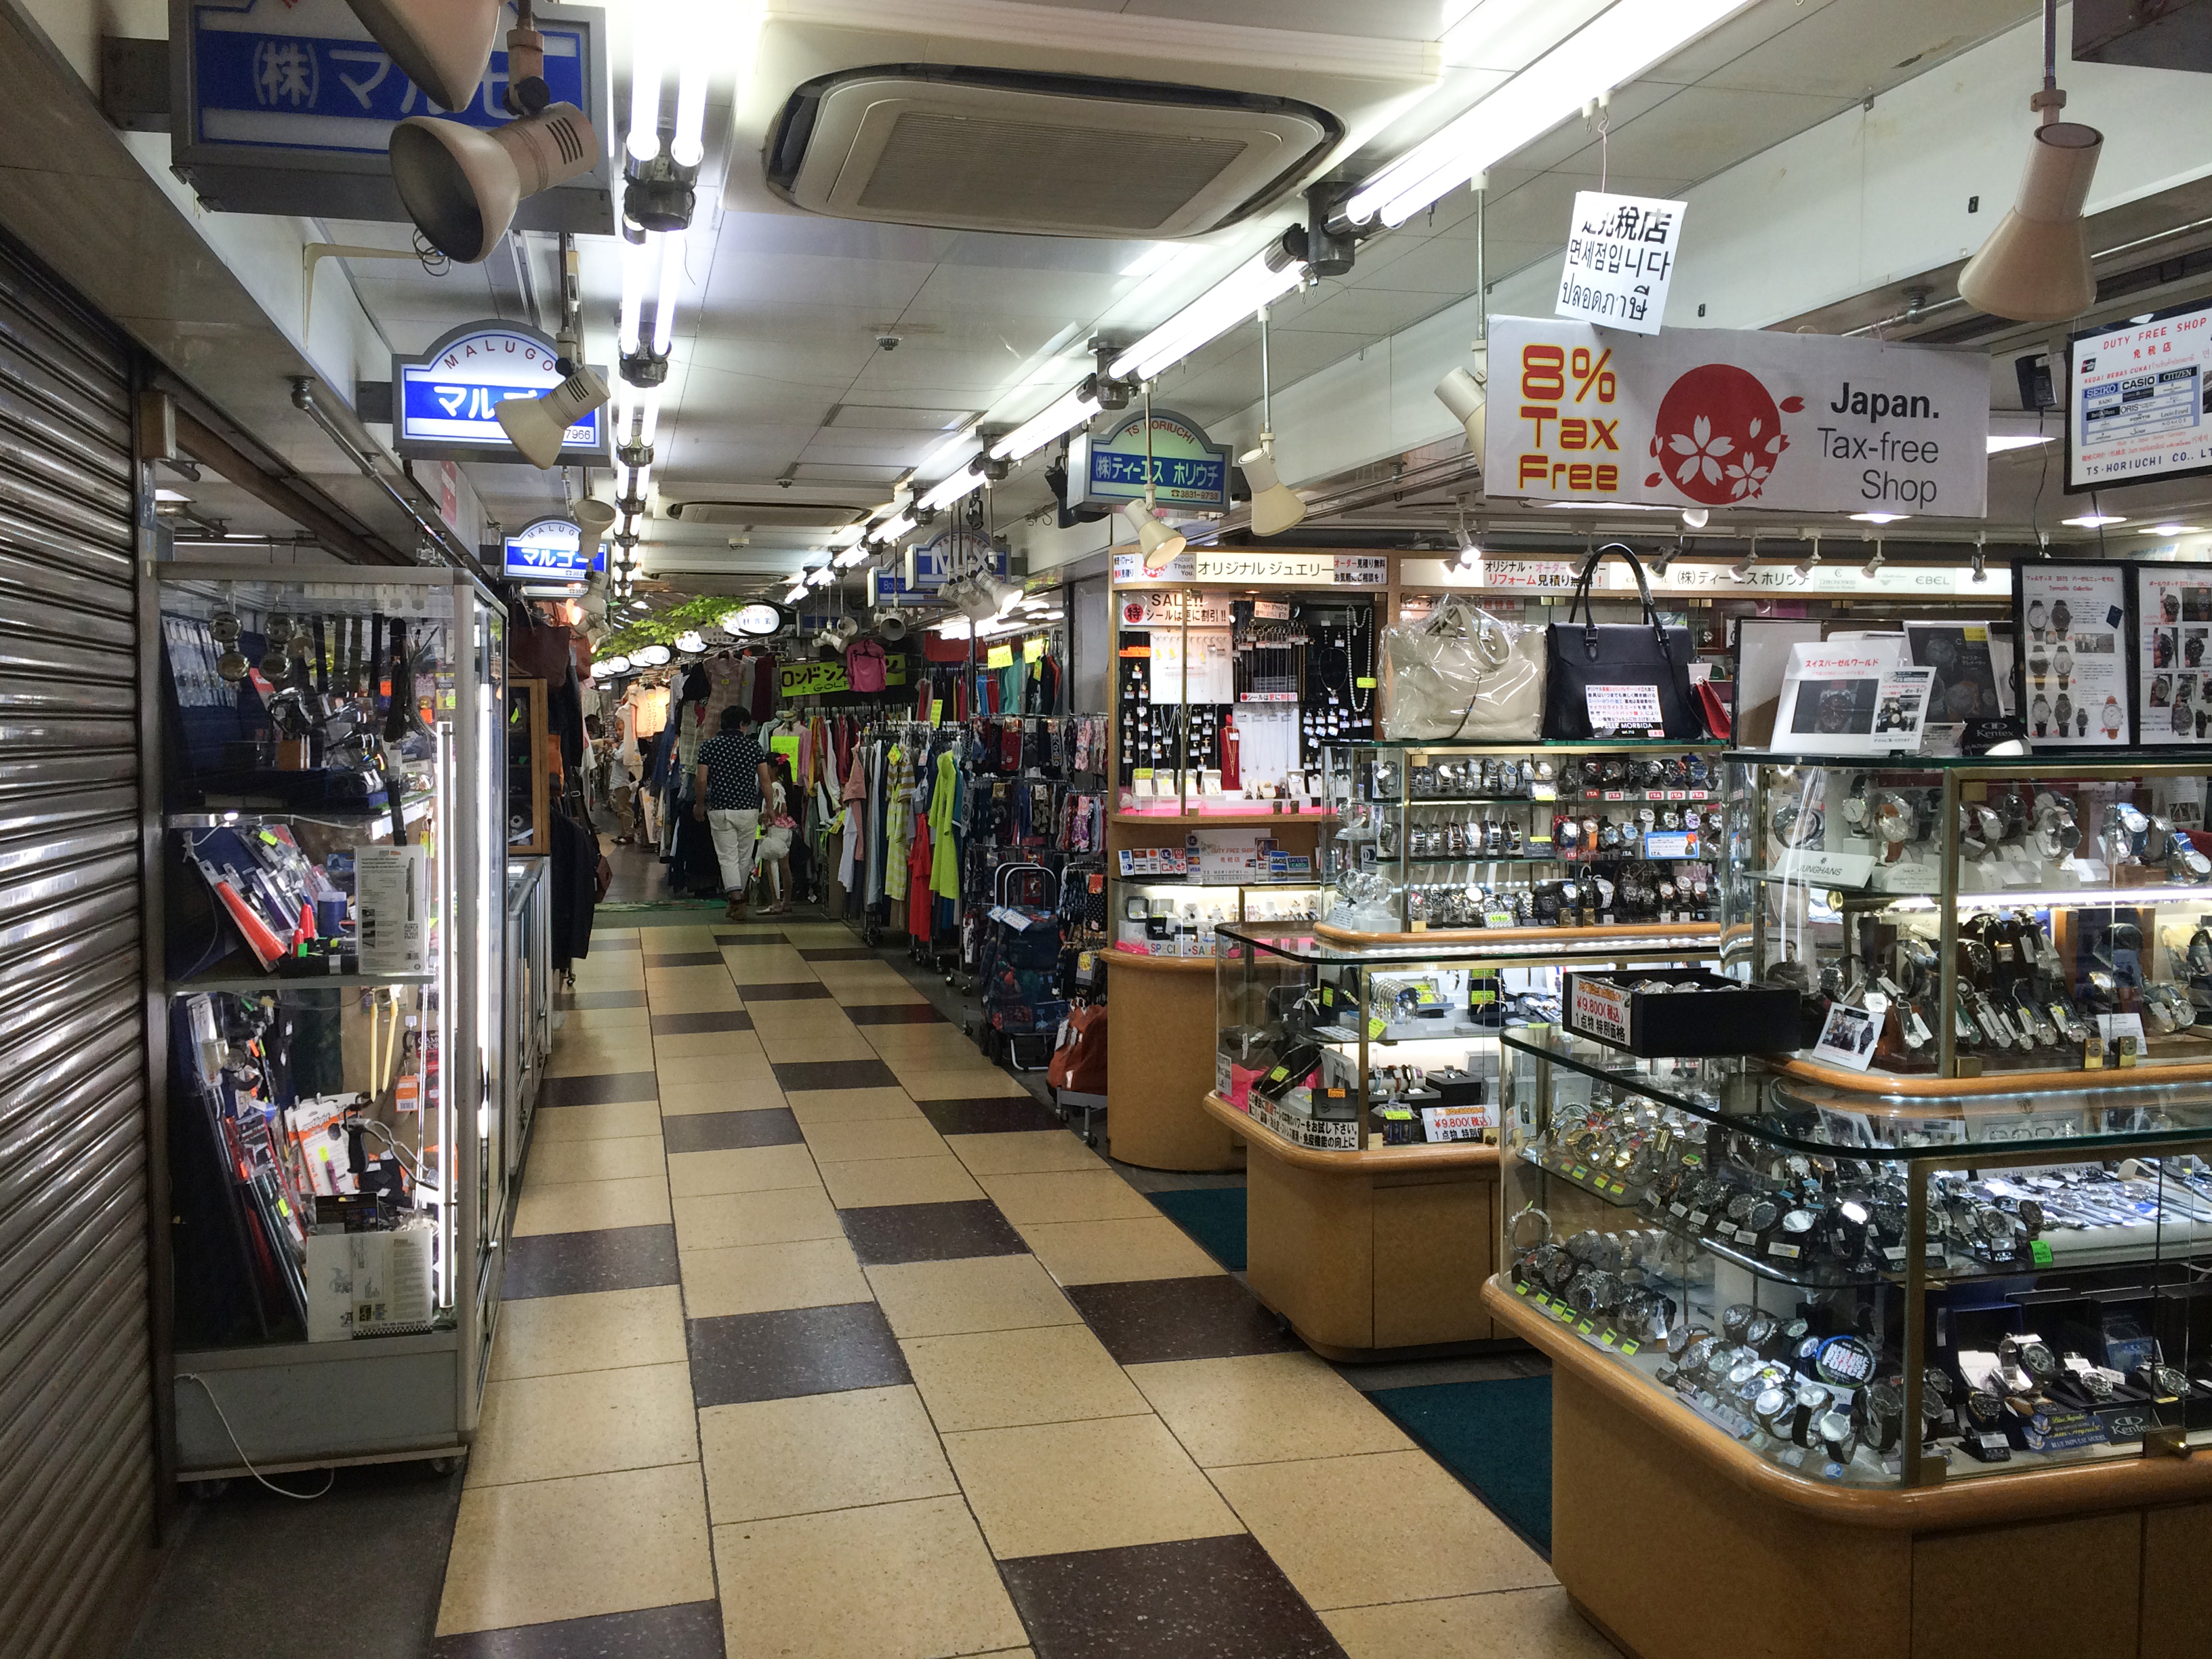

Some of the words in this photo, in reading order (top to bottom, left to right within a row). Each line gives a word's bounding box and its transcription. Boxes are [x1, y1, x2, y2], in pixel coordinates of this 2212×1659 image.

[1570, 238, 1671, 281] 면세점입니다
[1561, 272, 1651, 321] ปลอดภาษี
[2104, 335, 2131, 350] DUTY
[2138, 327, 2167, 342] FREE
[2177, 317, 2207, 333] SHOP
[444, 340, 554, 371] MALUGO
[2133, 342, 2172, 360] 免税店
[1521, 344, 1617, 405] 8%
[2086, 384, 2116, 398] SEIKO
[2122, 376, 2155, 391] CASIO
[2163, 368, 2192, 382] CITIZEN
[1830, 382, 1940, 424] Japan.
[2121, 403, 2139, 413] ORIS
[1125, 425, 1139, 437] TS
[1519, 405, 1620, 451] Tax
[1818, 427, 1940, 464] Tax-free
[1173, 462, 1218, 487] ホリウチ
[1517, 455, 1620, 493] Free
[1861, 469, 1937, 509] Shop
[527, 525, 575, 540] MALUG
[952, 534, 987, 550] CRNER
[521, 548, 589, 567] マルゴー
[1334, 558, 1385, 569] オーダー見積り無料
[1198, 561, 1265, 575] オリジナル
[1269, 561, 1334, 576] ジュエリー
[1916, 576, 1950, 585] EBEL
[1127, 606, 1141, 620] 特
[1805, 659, 1879, 668] スイスバーゼルワールド
[1977, 730, 2014, 739] Kentex
[1797, 865, 1843, 876] JUNGHANS
[1822, 1358, 1866, 1380] FORCE
